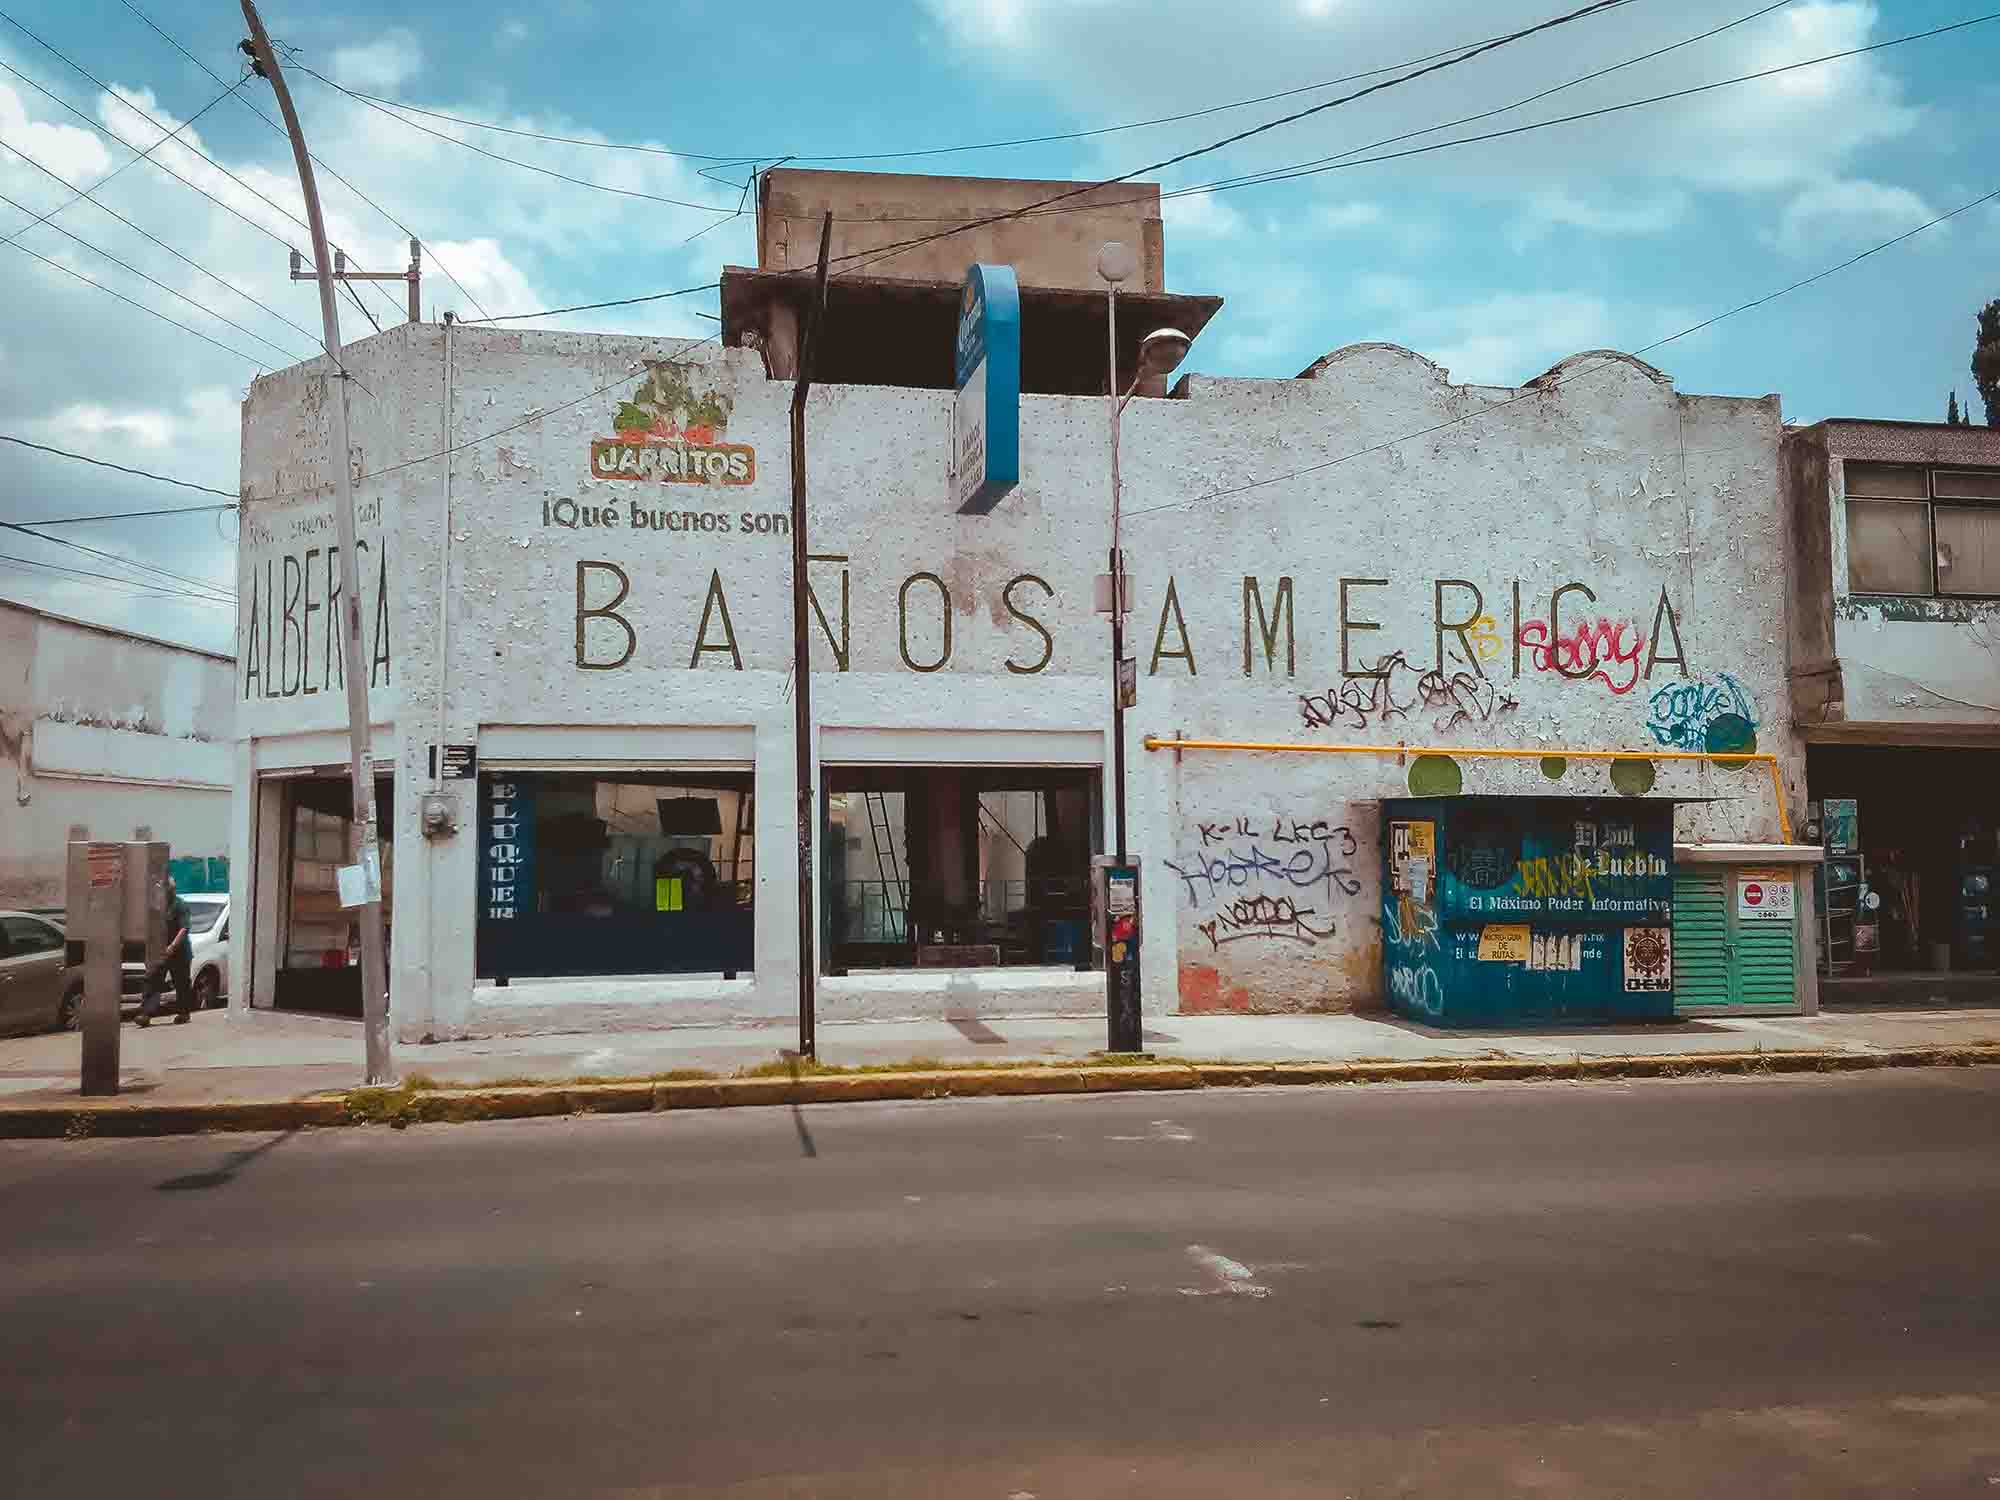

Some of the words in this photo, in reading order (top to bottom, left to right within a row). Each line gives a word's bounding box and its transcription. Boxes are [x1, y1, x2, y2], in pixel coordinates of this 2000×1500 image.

[542, 491, 620, 529] ¡Qué
[630, 500, 731, 533] buenos
[739, 510, 792, 534] son
[245, 536, 390, 699] ALBERA
[576, 555, 1056, 673] BAÑOS
[1149, 576, 1688, 680] AMERICA
[1469, 897, 1482, 910] El
[1489, 896, 1541, 911] Máximo
[1547, 897, 1585, 911] Poder
[1491, 950, 1516, 960] RUTAS
[1498, 942, 1509, 950] DE
